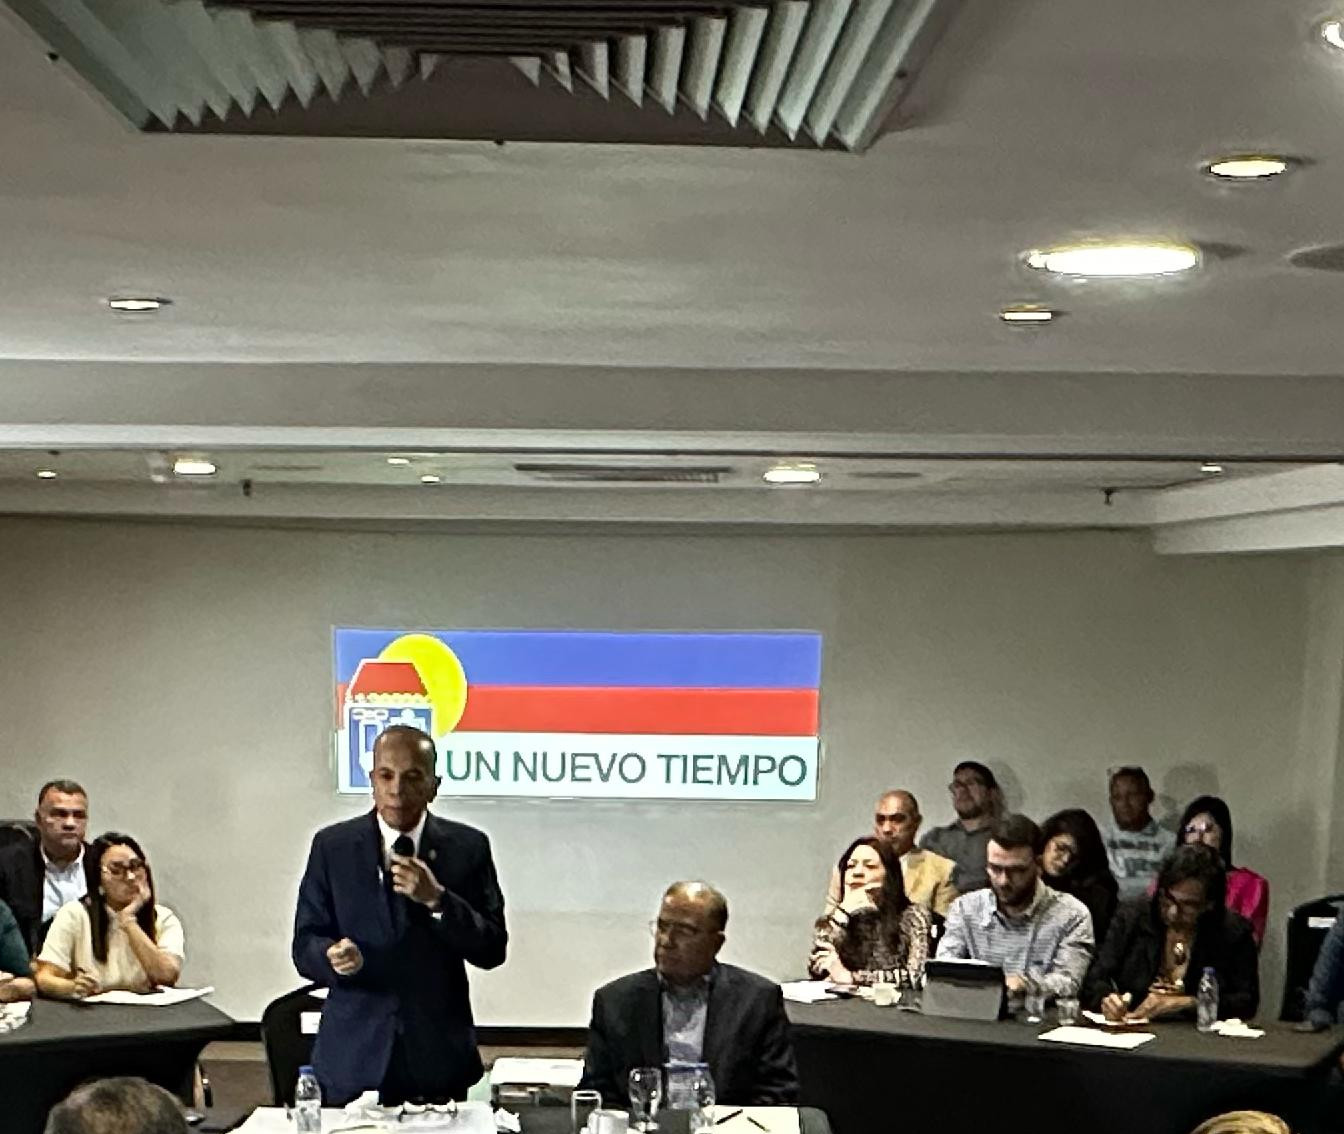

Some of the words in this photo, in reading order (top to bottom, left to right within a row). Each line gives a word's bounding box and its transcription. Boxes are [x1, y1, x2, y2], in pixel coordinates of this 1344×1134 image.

[446, 750, 500, 781] UN
[513, 750, 646, 783] NUEVO
[656, 754, 807, 786] TIEMPO
